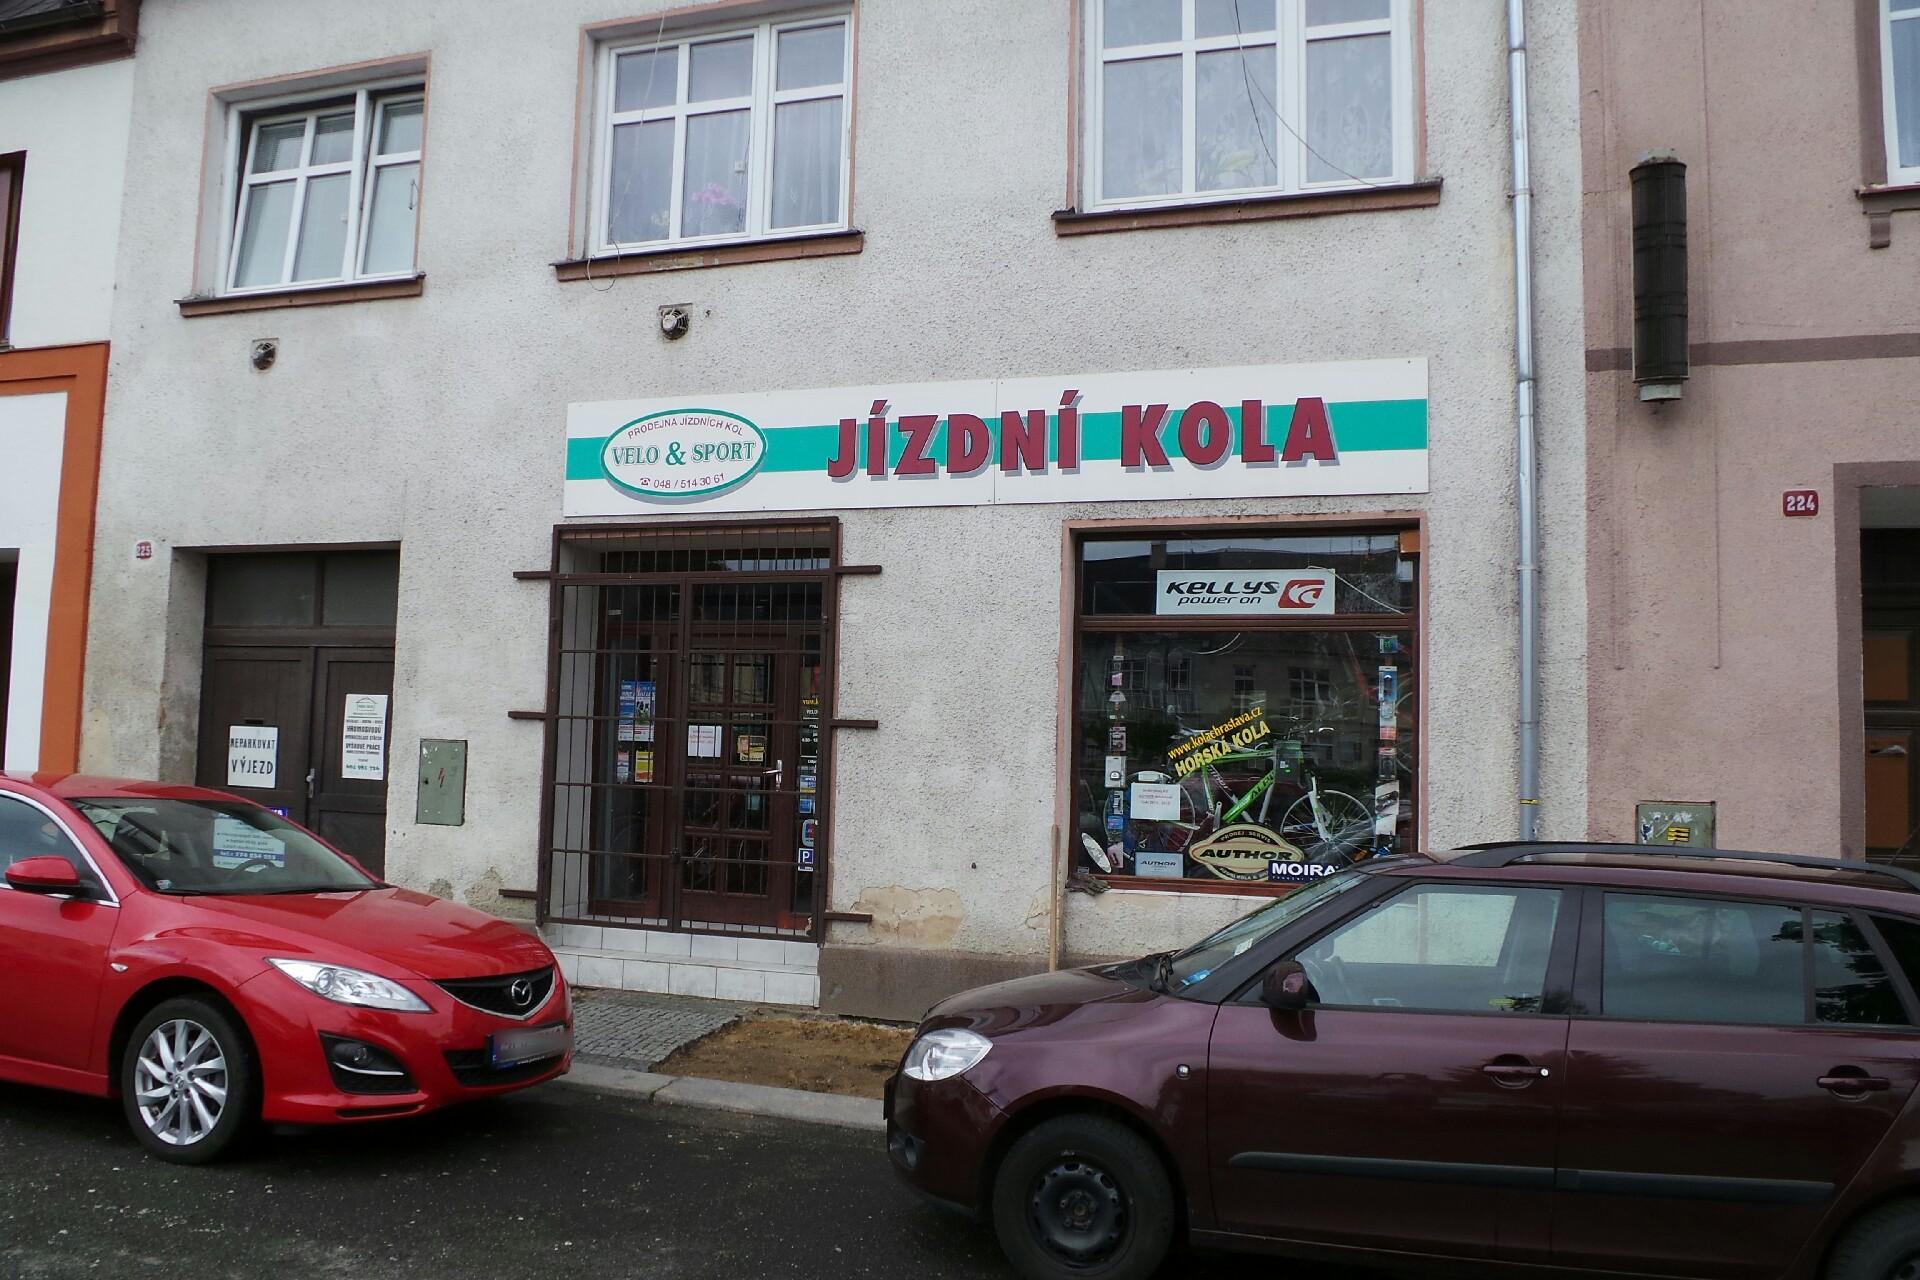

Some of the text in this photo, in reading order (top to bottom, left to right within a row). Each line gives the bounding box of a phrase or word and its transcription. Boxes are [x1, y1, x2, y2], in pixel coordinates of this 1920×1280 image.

[628, 415, 744, 439] PRODEJNA JÍZDNÍCH KOL
[827, 389, 1338, 480] JÍZDNÍ KOLA
[612, 441, 756, 466] VELO & SPORT
[653, 473, 724, 489] 048 / 514 30 61
[1786, 494, 1815, 511] 224
[1166, 581, 1279, 595] KELLYS
[1177, 596, 1261, 606] power on
[1168, 706, 1263, 760] www.kolachrastava.cz
[230, 737, 276, 749] NEPARKOVAT
[1174, 720, 1271, 777] HORSKÁ KOLA
[231, 755, 274, 775] VÝJEZD
[1200, 849, 1293, 861] AUTHOR
[1272, 862, 1336, 877] MOIRA
